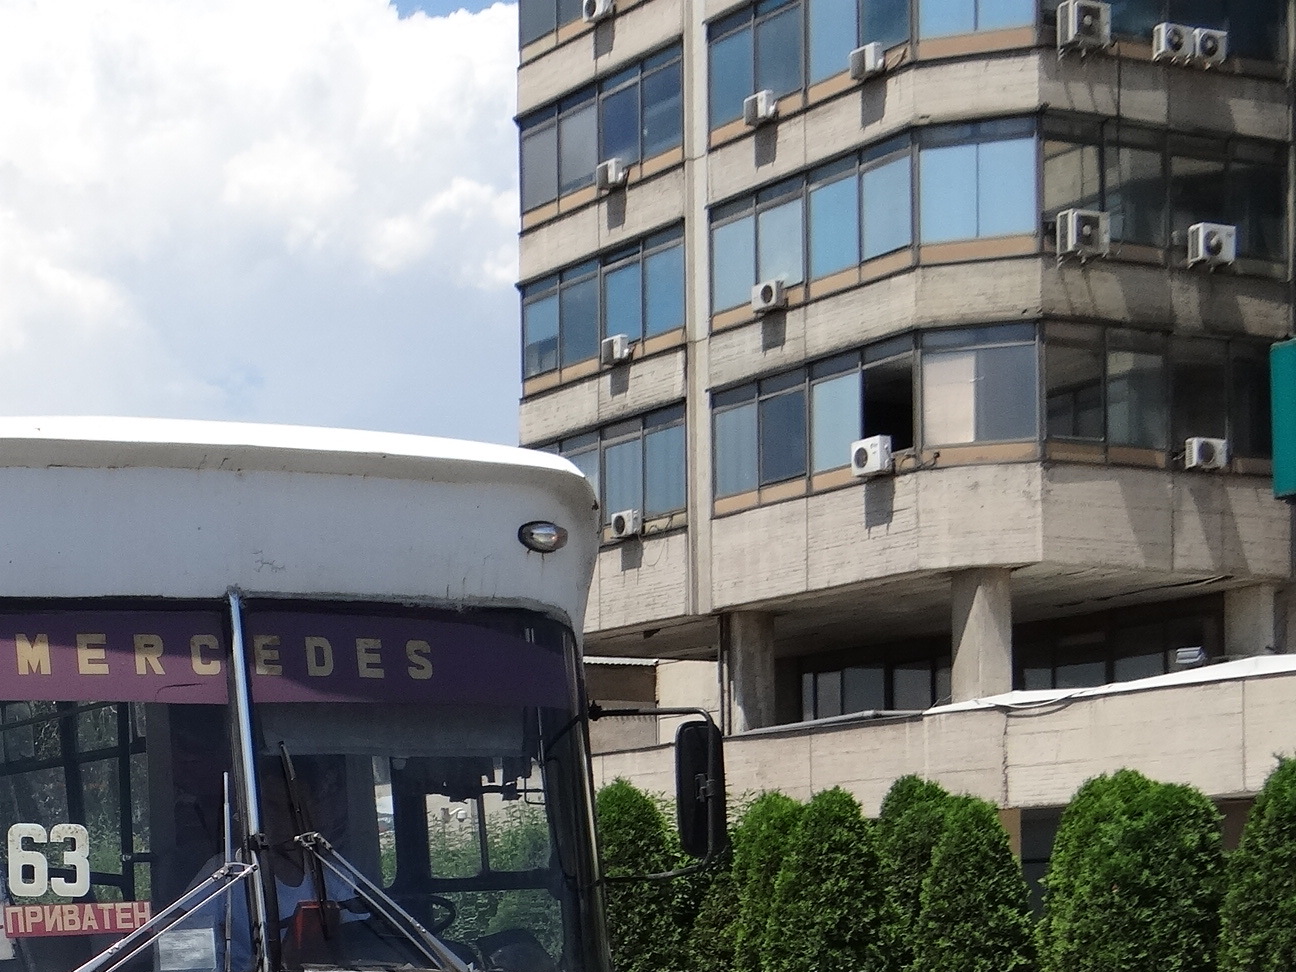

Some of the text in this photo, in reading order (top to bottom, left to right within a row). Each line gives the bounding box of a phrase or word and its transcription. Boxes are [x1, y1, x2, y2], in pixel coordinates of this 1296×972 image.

[16, 633, 434, 680] MERCEDES
[7, 823, 90, 897] 63
[5, 901, 152, 934] ПРИВАТЕН
